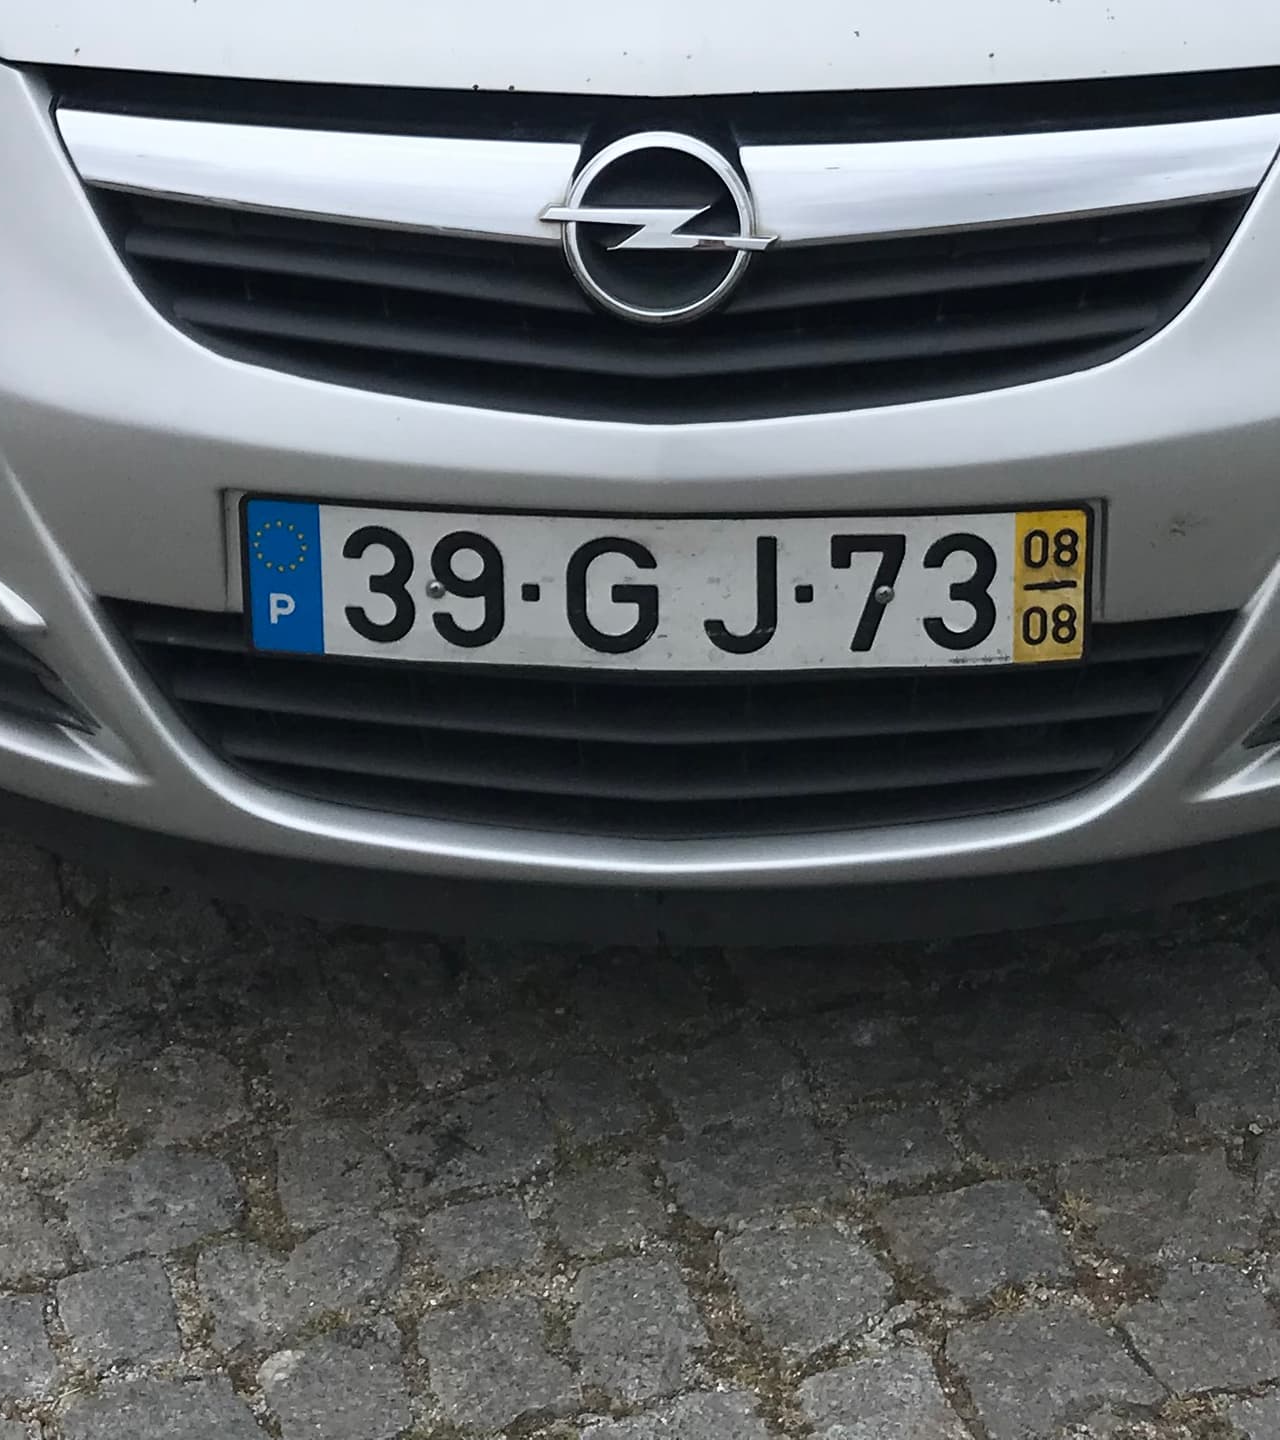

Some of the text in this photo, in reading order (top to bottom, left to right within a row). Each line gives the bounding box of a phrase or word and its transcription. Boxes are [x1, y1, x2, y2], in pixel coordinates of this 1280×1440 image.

[1023, 528, 1079, 569] 08
[269, 592, 296, 624] P
[1022, 603, 1077, 646] 08
